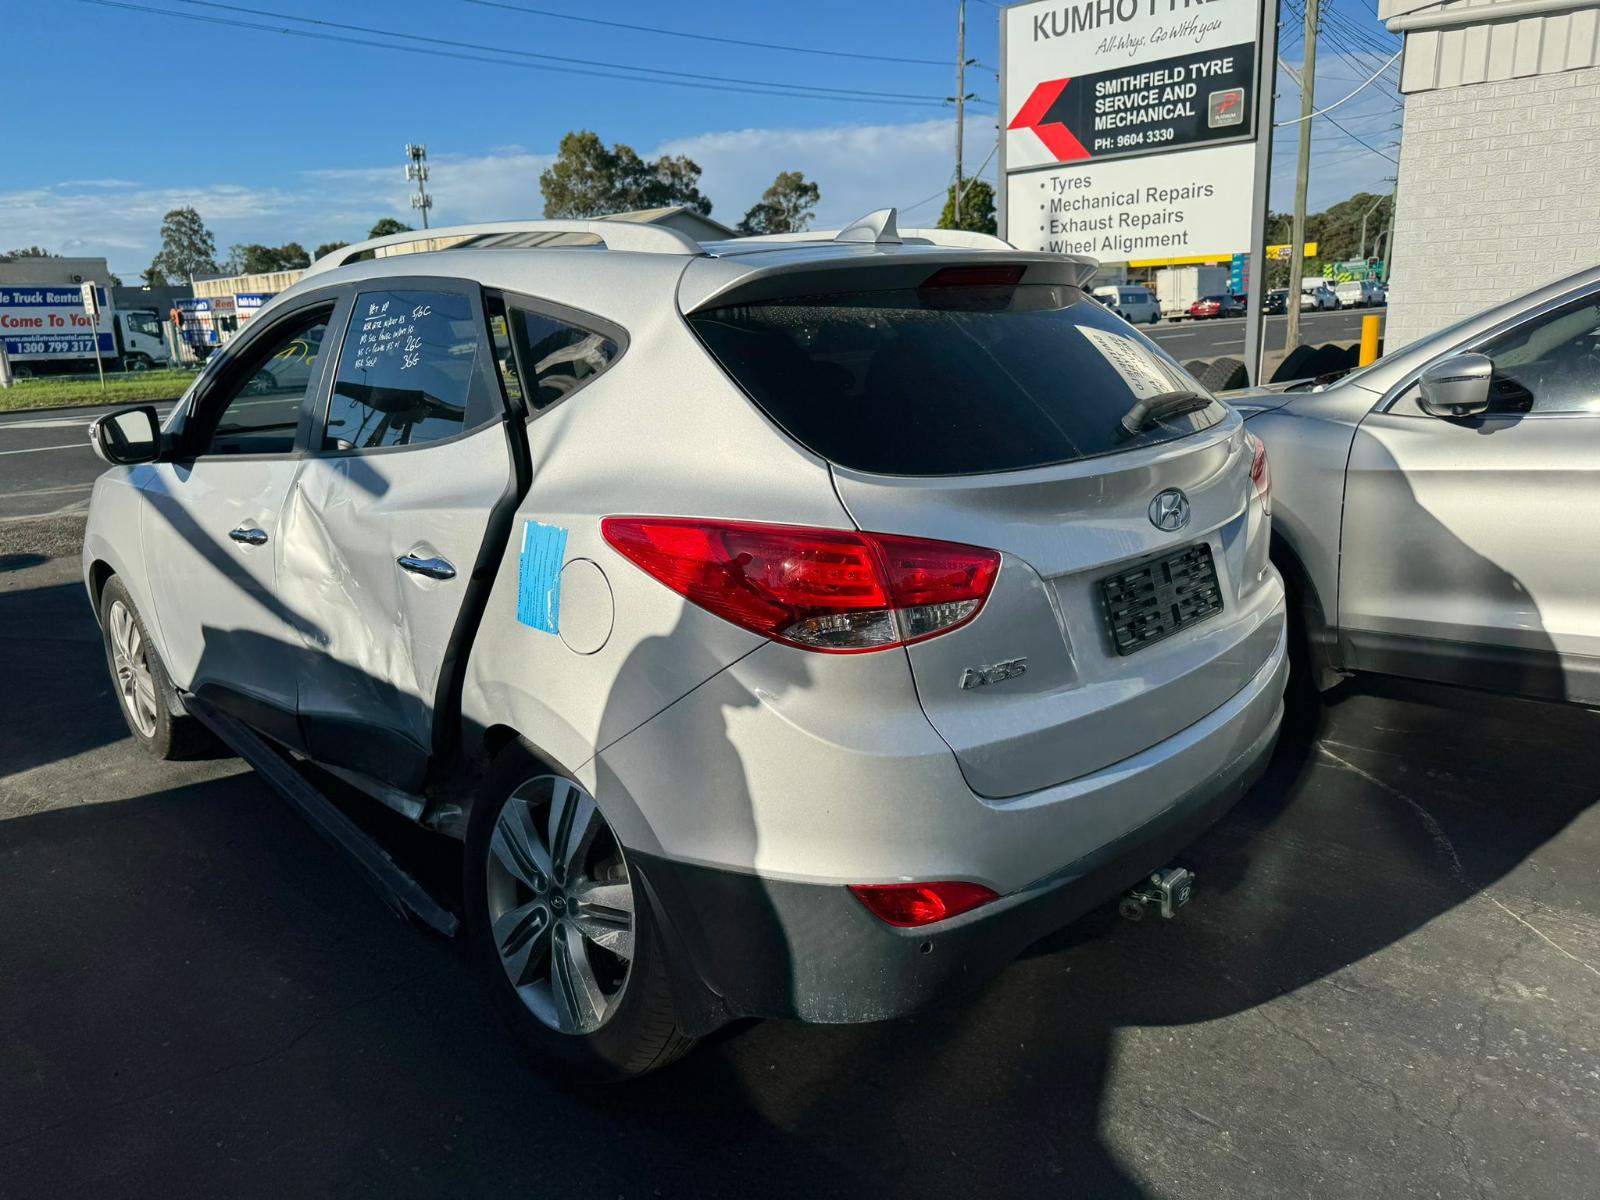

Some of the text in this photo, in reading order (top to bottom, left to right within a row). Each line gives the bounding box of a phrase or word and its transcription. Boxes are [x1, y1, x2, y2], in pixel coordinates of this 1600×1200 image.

[1033, 0, 1138, 42] KUMHO
[1195, 19, 1222, 44] you
[1095, 57, 1234, 97] SMITHFIELD TYRE
[1095, 83, 1197, 114] SERVICE AND
[1095, 102, 1195, 131] MECHANICAL
[1094, 128, 1174, 150] PH: 9604 3330
[1050, 176, 1092, 195] Tyres
[1050, 182, 1214, 214] Mechanical Repairs
[1050, 208, 1184, 235] Exhaust Repairs
[1050, 230, 1189, 254] Wheel Alignment
[12, 291, 43, 303] Truck
[1, 314, 43, 328] Come
[47, 314, 65, 327] To
[17, 341, 93, 353] 1300 799 317
